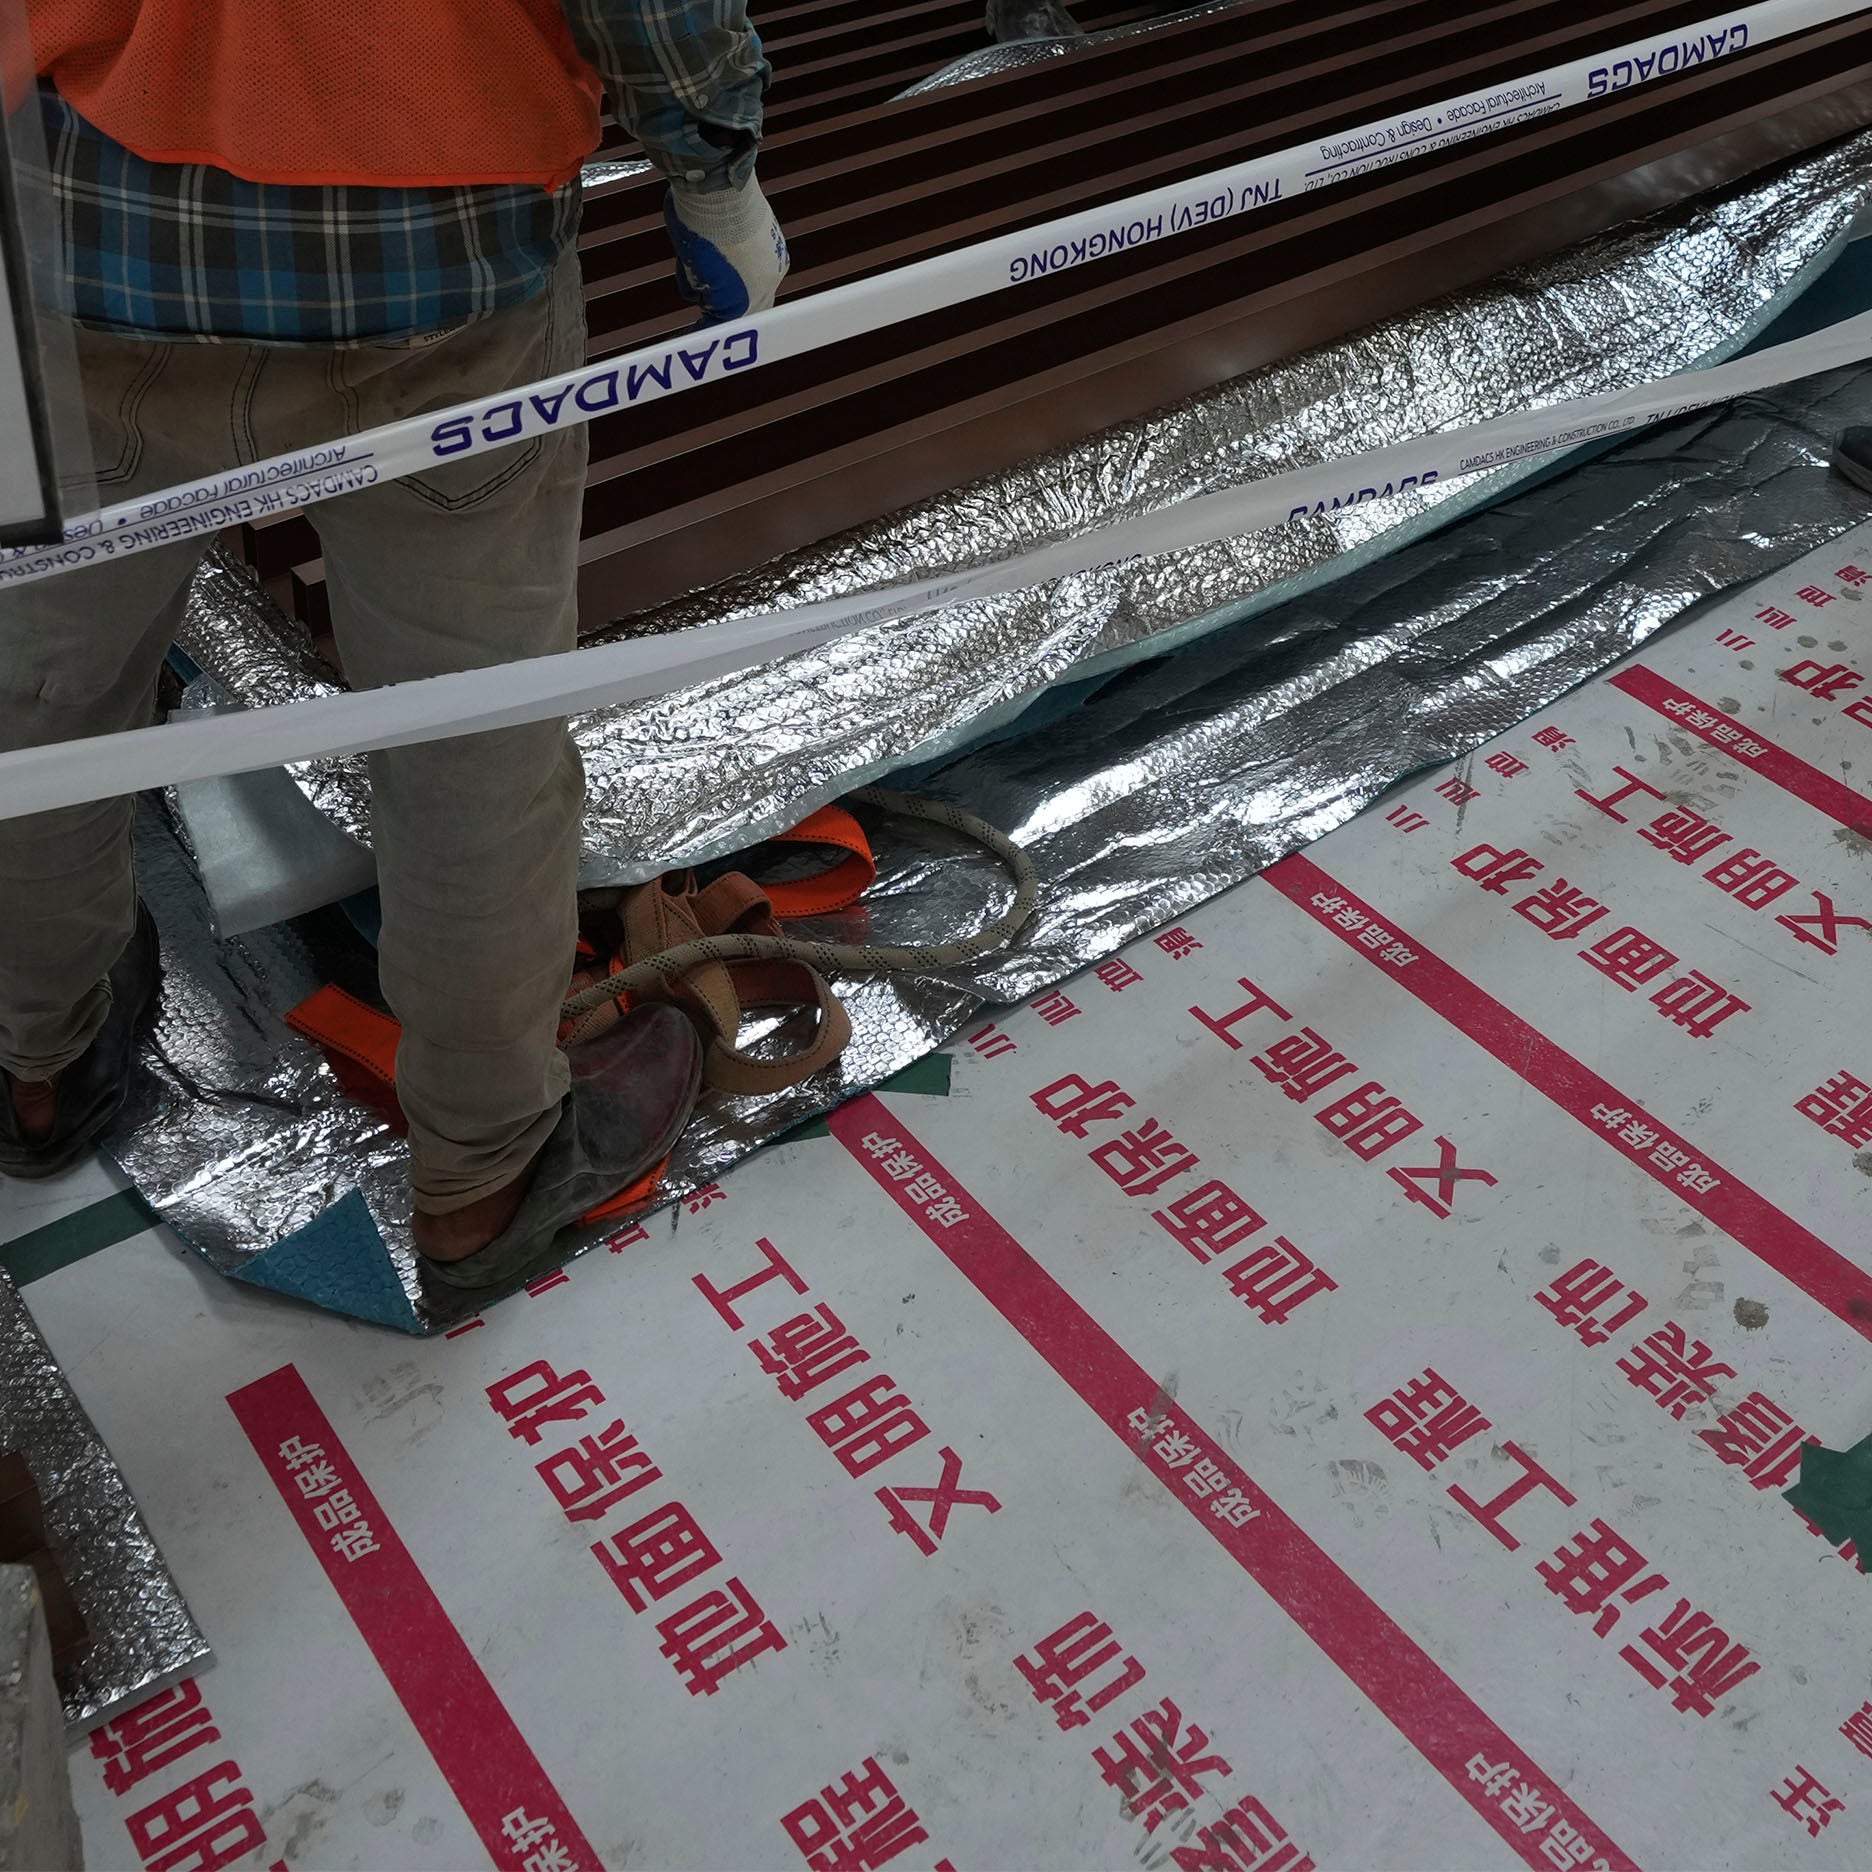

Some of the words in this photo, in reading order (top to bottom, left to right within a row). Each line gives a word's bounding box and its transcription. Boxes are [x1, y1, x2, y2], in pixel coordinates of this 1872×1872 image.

[1483, 79, 1548, 112] Architectural
[1582, 22, 1754, 101] CAMDACS
[1318, 127, 1387, 163] Contracting
[1384, 127, 1396, 142] &
[1394, 112, 1433, 139] Design
[1444, 98, 1487, 124] Facade
[1164, 186, 1239, 233] (DEV)
[1236, 176, 1285, 210] TNJ
[1003, 213, 1167, 283] HONGKONG
[431, 326, 762, 457] CAMDACS
[283, 460, 380, 507] CAMDACS
[1458, 450, 1496, 471] CAMDACS
[1493, 448, 1506, 461] HK
[1504, 435, 1554, 458] ENGINEERING
[1556, 421, 1609, 444] CONSTRUCTION
[117, 495, 253, 555] ENGINEERING
[253, 489, 284, 514] HK
[96, 537, 116, 554] &
[1718, 566, 1865, 650] 小心地滑
[1652, 693, 1771, 763] 成品保护
[1388, 727, 1572, 832] 小心地滑
[1577, 767, 1872, 955] 文明施工
[1294, 884, 1420, 972] 成品保护
[1452, 844, 1750, 1037] 地面保护
[1190, 978, 1497, 1218] 文明施工
[845, 1123, 974, 1236] 成品保护
[1579, 1091, 1724, 1198] 成品保护
[1031, 1074, 1337, 1323] 地面保护
[693, 1239, 1001, 1555] 文明施工
[1536, 1259, 1856, 1559] 修装饰
[258, 1424, 390, 1572] 成品保护
[1116, 1393, 1269, 1536] 成品保护
[486, 1360, 787, 1695] 地面保护
[1365, 1369, 1759, 1716] 标准工程
